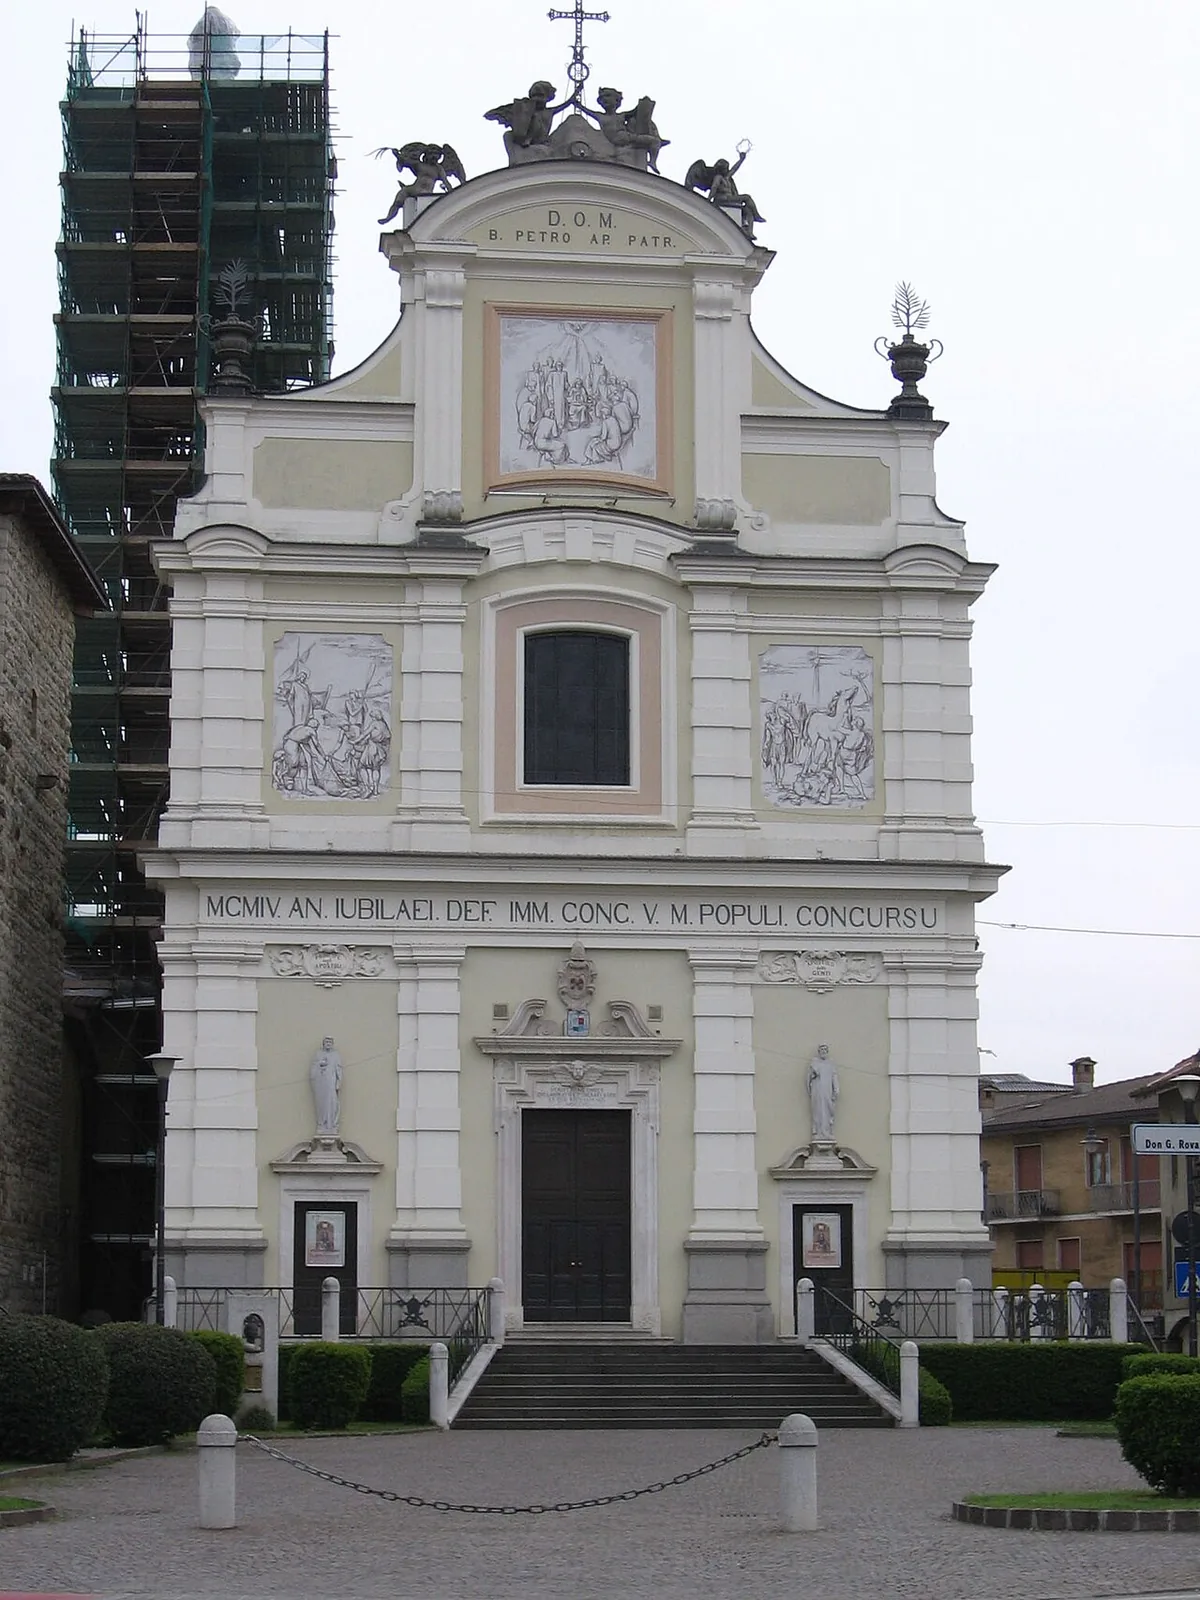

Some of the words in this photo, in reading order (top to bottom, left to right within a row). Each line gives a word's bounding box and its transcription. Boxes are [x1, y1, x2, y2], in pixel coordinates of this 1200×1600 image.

[489, 229, 503, 241] B.
[516, 230, 571, 244] PETRO
[628, 235, 676, 249] PATR.
[207, 895, 281, 918] MCMIV.
[288, 896, 328, 920] AN.
[335, 897, 440, 921] IUBILAEI.
[446, 899, 497, 923] DEF.
[509, 900, 555, 924] IMM.
[561, 901, 635, 925] CONC.
[699, 903, 788, 927] POPULI.
[796, 905, 938, 930] CONCURSU
[1145, 1139, 1162, 1149] Don
[1165, 1140, 1175, 1149] G.
